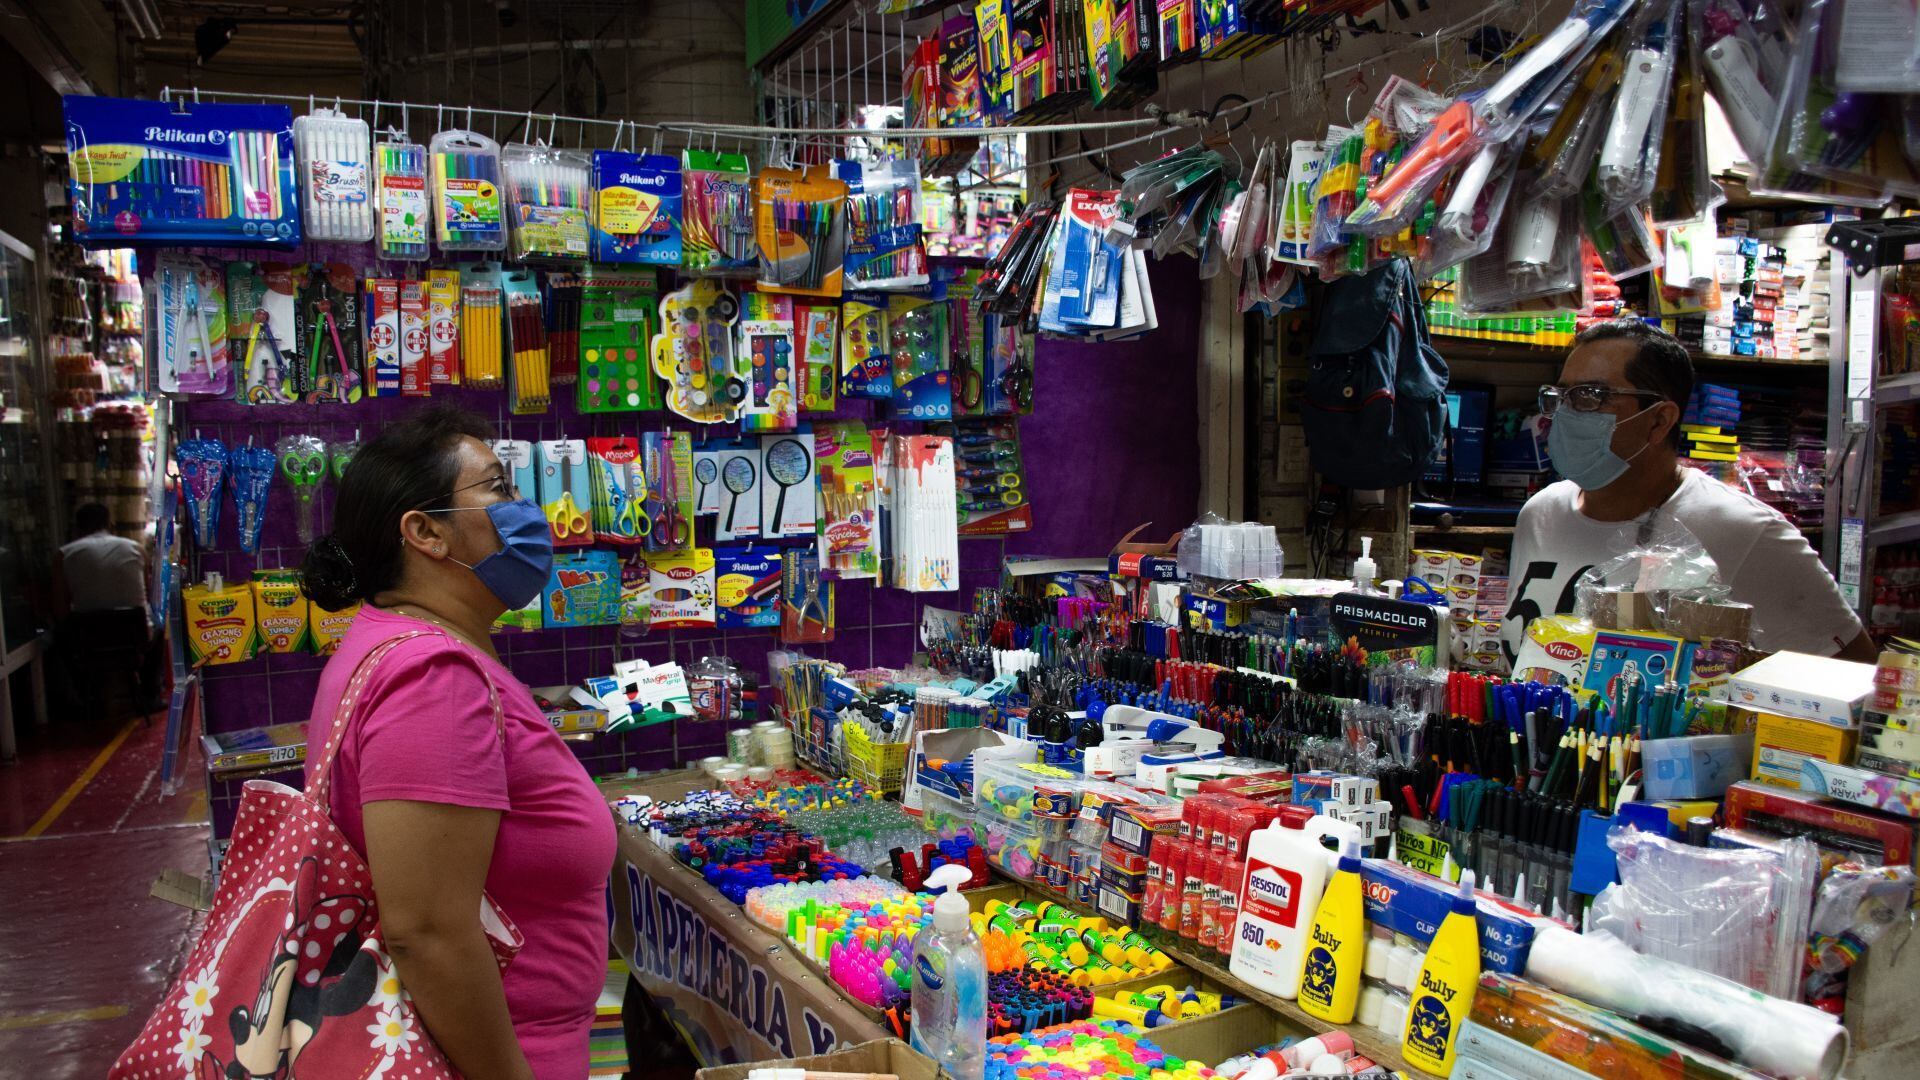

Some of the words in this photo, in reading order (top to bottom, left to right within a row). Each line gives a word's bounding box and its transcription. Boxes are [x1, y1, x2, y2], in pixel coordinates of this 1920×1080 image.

[144, 126, 206, 143] Pelikan
[326, 172, 357, 186] Brush
[619, 173, 654, 185] Pelikan
[605, 449, 634, 459] Maped
[732, 562, 760, 571] Pelikan
[669, 569, 692, 578] Vinci
[264, 589, 296, 598] Crayola
[201, 598, 235, 608] Crayola
[650, 608, 700, 618] Modelina
[1335, 604, 1427, 628] PRISMACOLOR
[262, 617, 302, 628] CRAYONES
[320, 616, 354, 628] CRAYONE
[201, 628, 243, 641] CRAYONES
[268, 626, 296, 635] JUMBO
[208, 637, 237, 647] JUMBO
[277, 637, 287, 646] 12
[218, 647, 230, 657] 24
[1549, 644, 1578, 659] Vinci
[665, 677, 681, 686] grip
[1832, 777, 1848, 785] 360
[1830, 786, 1857, 801] YARK
[1211, 834, 1223, 845] ritt
[1431, 838, 1449, 857] NO
[1148, 865, 1160, 876] ritt
[1250, 875, 1288, 899] RESISTOL
[1241, 921, 1264, 946] 850
[1416, 920, 1435, 935] CLIP
[1312, 923, 1342, 952] Bully
[1485, 925, 1502, 942] No.
[1504, 934, 1513, 946] 2
[627, 861, 796, 1058] PAPELERIA
[1481, 947, 1508, 966] ZADO
[1420, 968, 1458, 1003] Bully
